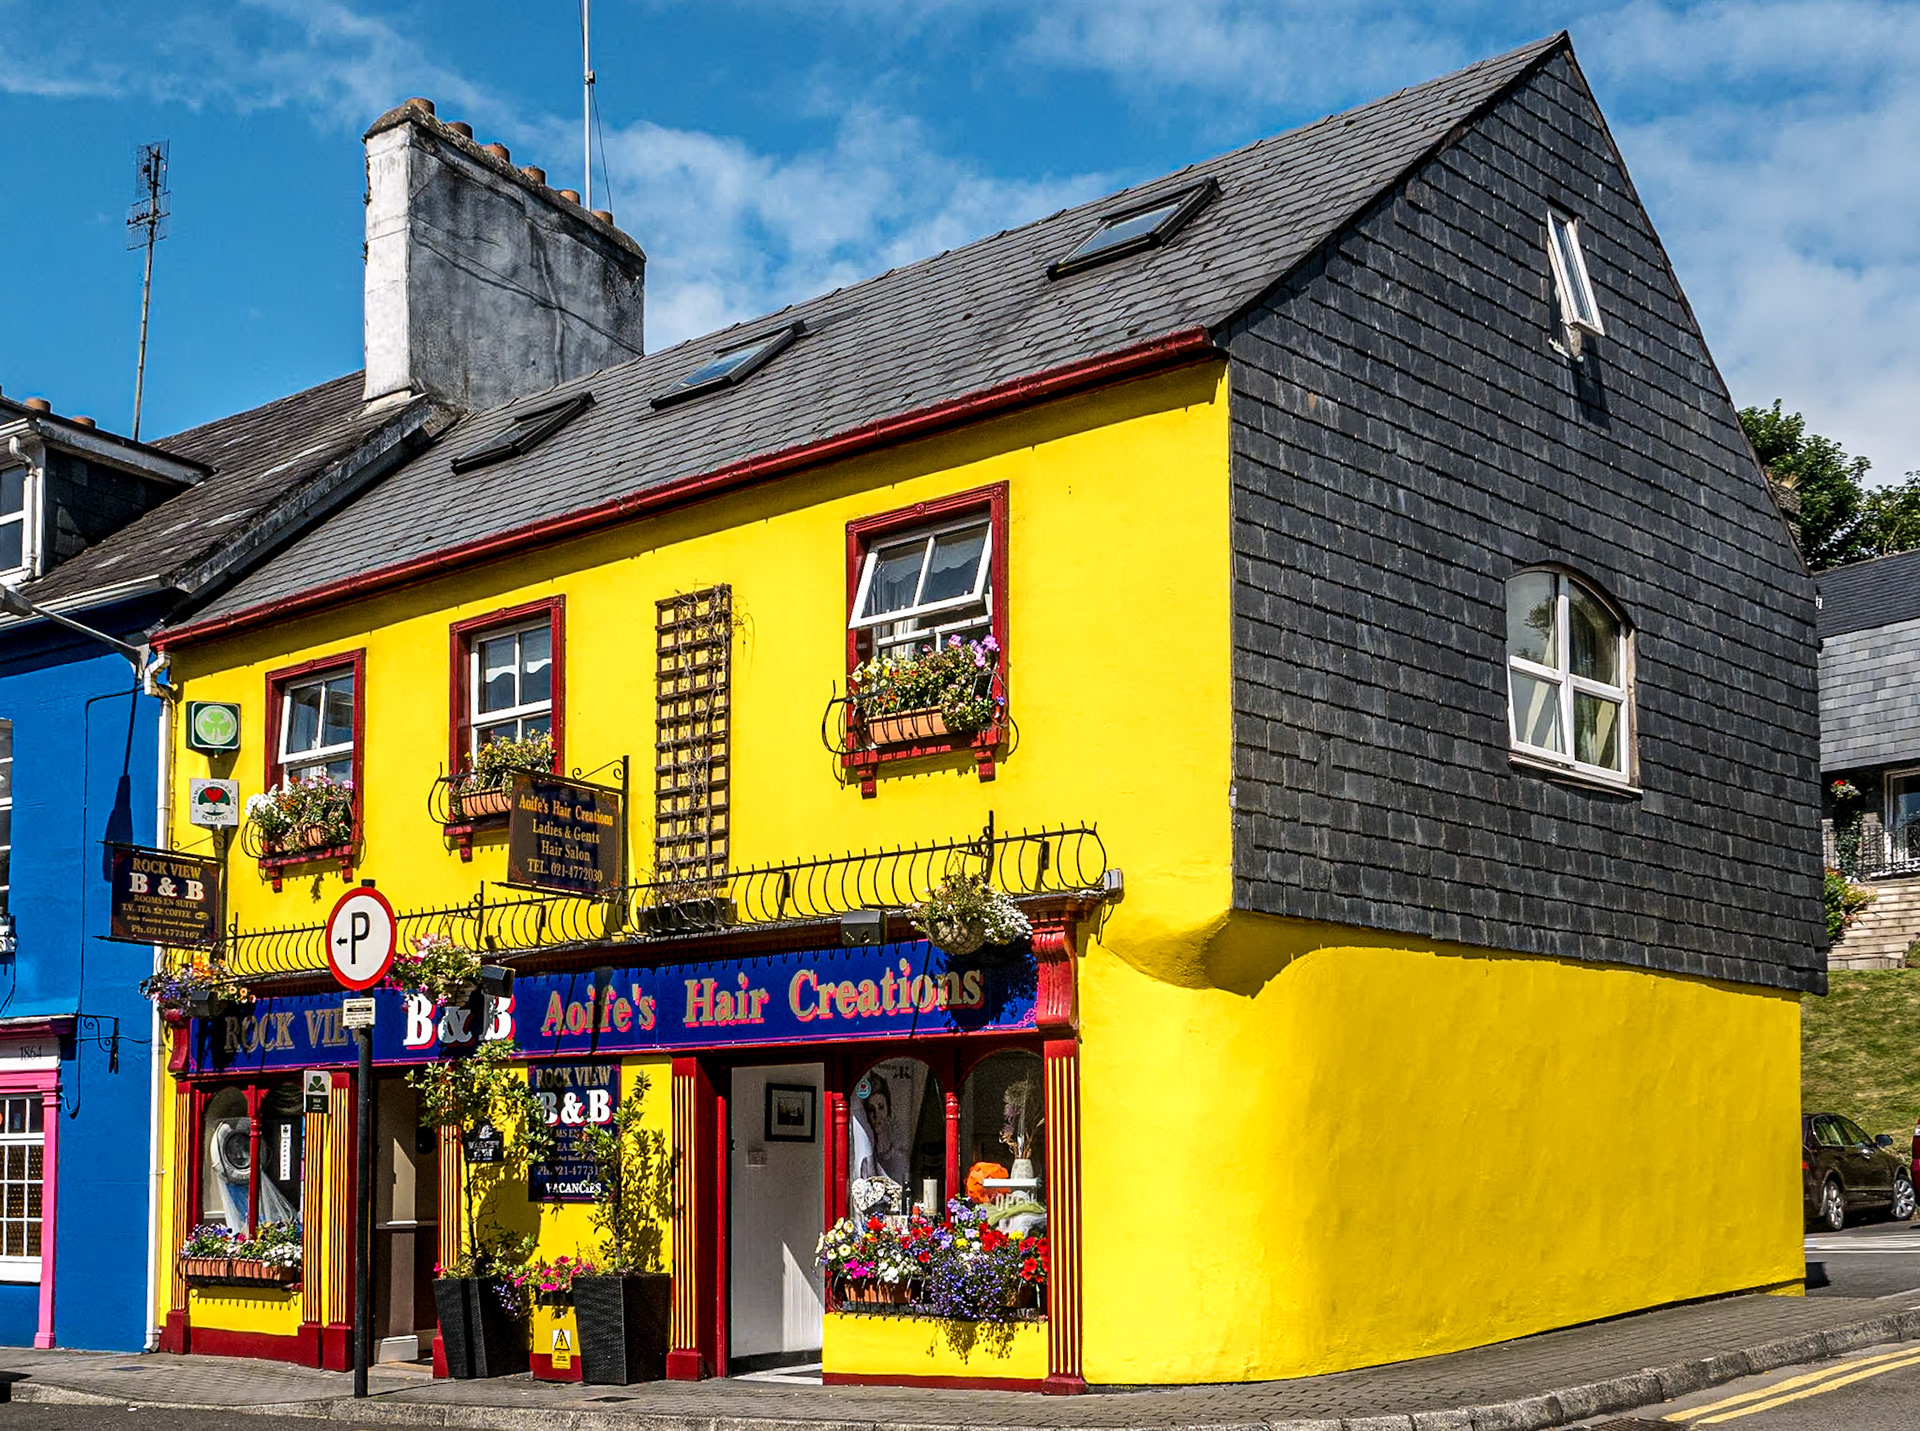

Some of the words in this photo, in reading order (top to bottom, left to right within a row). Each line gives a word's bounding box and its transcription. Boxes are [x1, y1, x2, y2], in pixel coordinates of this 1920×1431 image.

[519, 794, 549, 814] Aoife's
[552, 800, 571, 819] Hair
[575, 805, 613, 827] Creations
[532, 818, 562, 838] Ladies
[564, 825, 571, 841] &
[573, 826, 600, 845] Gents
[541, 840, 562, 857] Hair
[564, 844, 591, 862] Salon
[133, 857, 167, 875] ROCK
[169, 862, 201, 880] VIEW
[527, 858, 549, 875] TEL.
[550, 862, 603, 883] 021-4772030
[129, 872, 151, 895] B
[157, 876, 178, 898] &
[184, 879, 206, 902] B
[134, 894, 162, 905] ROOMS
[163, 898, 174, 906] EN
[175, 901, 198, 909] SUITE
[137, 905, 151, 914] TEA
[164, 908, 192, 919] COFFEE
[351, 911, 370, 965] P
[541, 983, 656, 1037] Aoife's
[682, 971, 770, 1028] Hair
[788, 957, 984, 1022] Creations
[223, 1011, 295, 1053] ROCK
[304, 1007, 361, 1048] VIE
[20, 1045, 42, 1061] 1864
[535, 1066, 573, 1089] ROCK
[574, 1064, 612, 1087] VIEW
